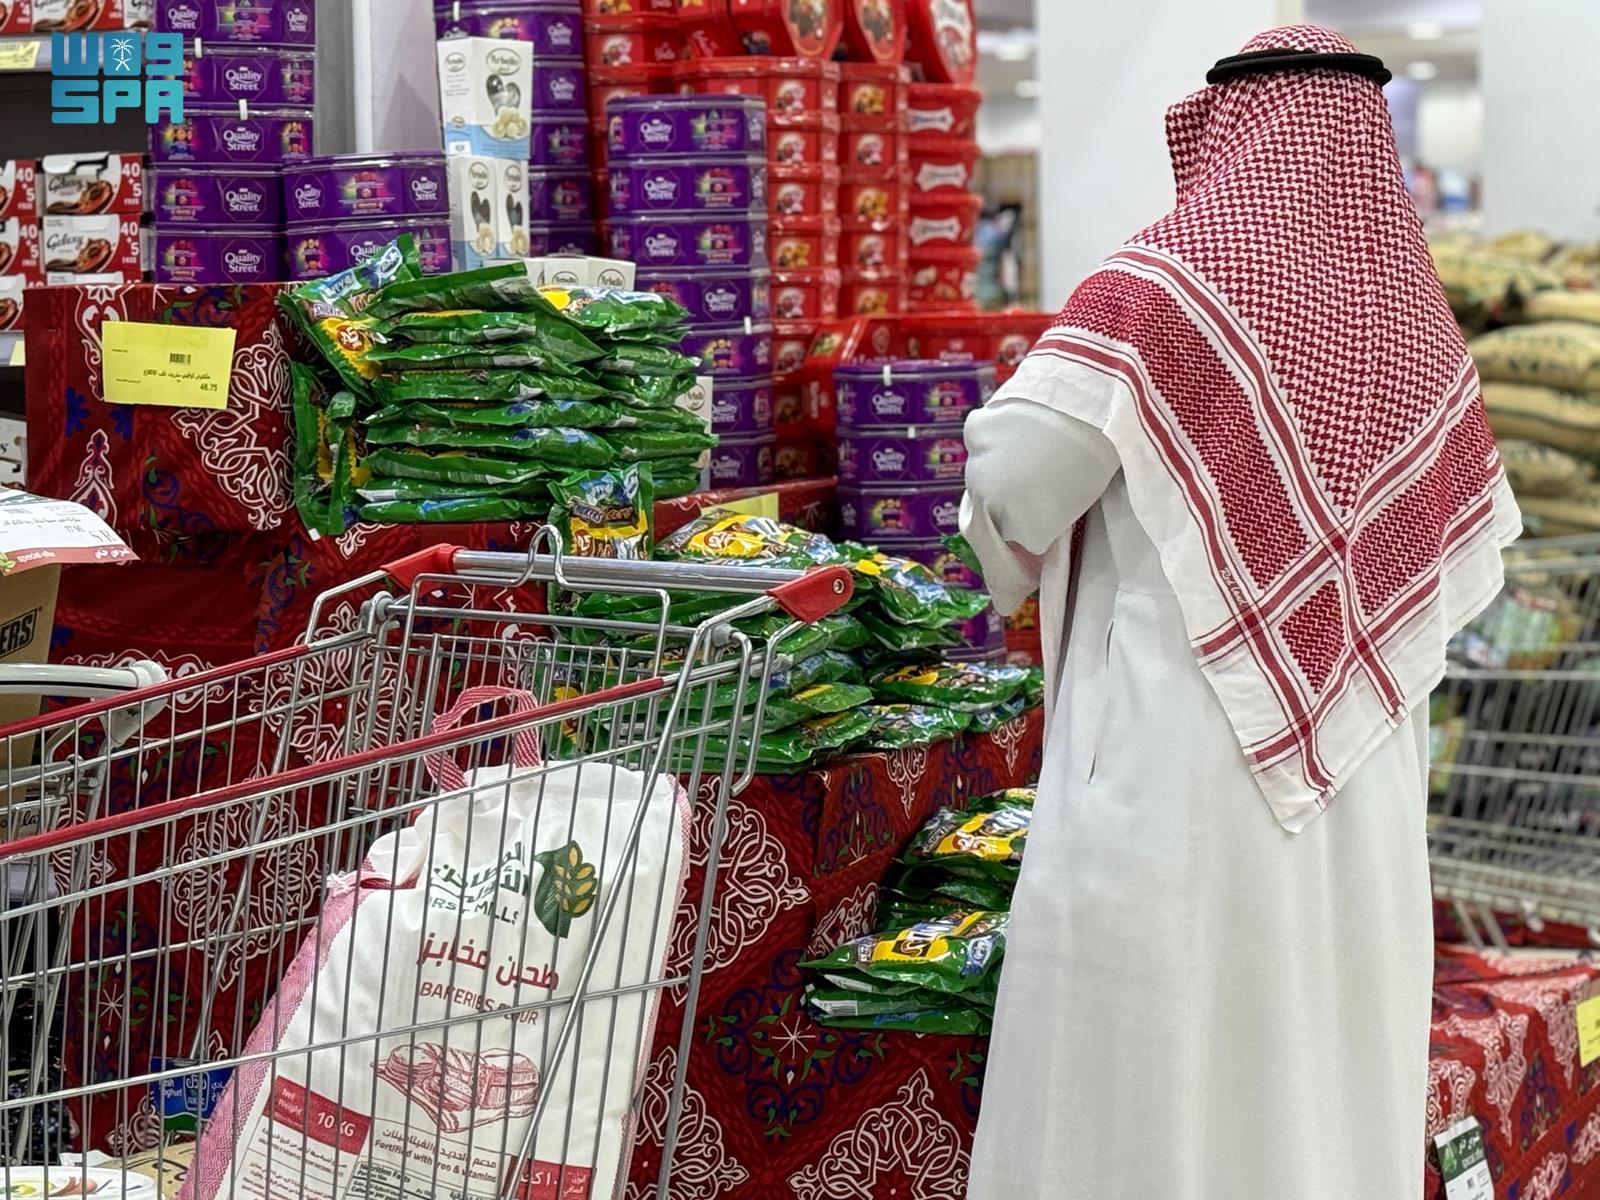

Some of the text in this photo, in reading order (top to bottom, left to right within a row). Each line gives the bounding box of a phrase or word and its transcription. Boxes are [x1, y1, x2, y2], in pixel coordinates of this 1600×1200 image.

[168, 9, 199, 22] Quality
[287, 11, 308, 23] Quality
[171, 20, 197, 30] Street
[288, 22, 307, 32] Street
[226, 69, 262, 83] Quality
[230, 81, 259, 91] Street
[223, 130, 260, 143] Quality
[227, 141, 257, 151] Street
[16, 168, 34, 182] 40
[122, 162, 140, 177] 40
[132, 183, 142, 197] 5
[412, 181, 438, 194] Quality
[26, 187, 35, 202] 5
[226, 191, 262, 204] Quality
[295, 189, 321, 201] Quality
[415, 192, 437, 201] Street
[230, 202, 260, 212] Street
[298, 199, 320, 209] Street
[20, 224, 38, 239] 40
[120, 222, 138, 236] 40
[47, 234, 83, 251] Galaxy
[131, 242, 140, 256] 5
[30, 244, 39, 258] 5
[351, 245, 385, 258] Quali
[225, 252, 262, 265] Quality
[229, 263, 260, 273] Street
[705, 292, 738, 306] Quality
[709, 303, 735, 313] Street
[200, 383, 217, 392] 48.75
[416, 932, 560, 991] طحين مخابز
[317, 1111, 335, 1130] 10
[337, 1120, 356, 1137] KG
[360, 1163, 392, 1177] Nurition
[392, 1170, 411, 1183] Fats
[414, 1152, 433, 1166] with
[436, 1160, 452, 1172] ron
[461, 1167, 497, 1183] vtamins
